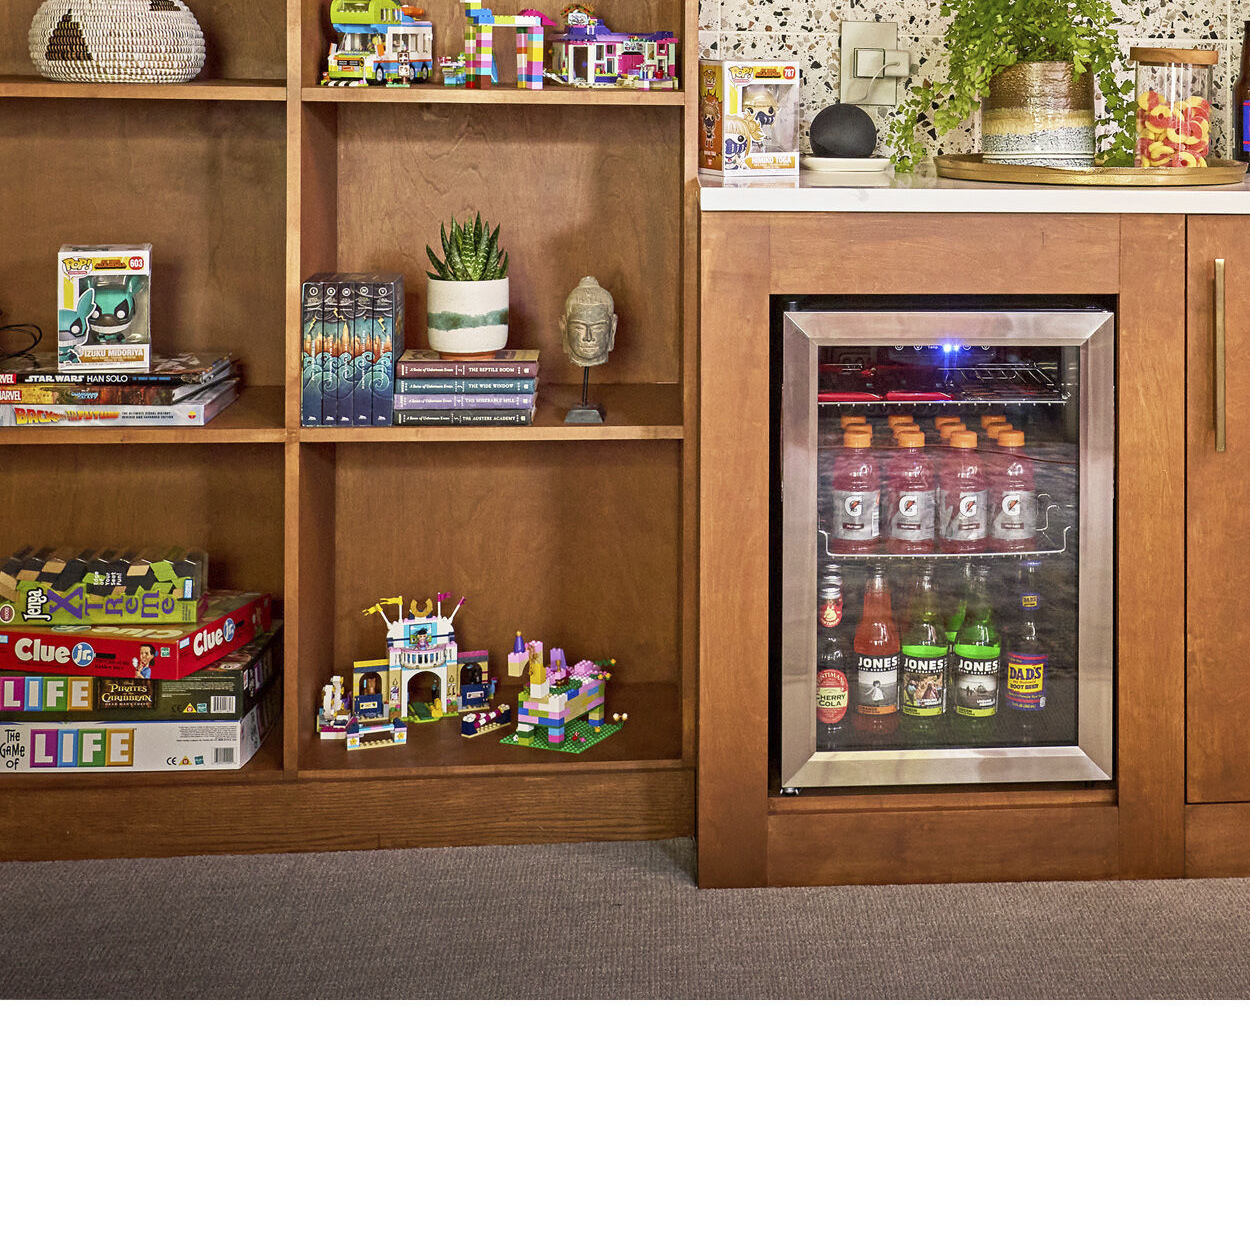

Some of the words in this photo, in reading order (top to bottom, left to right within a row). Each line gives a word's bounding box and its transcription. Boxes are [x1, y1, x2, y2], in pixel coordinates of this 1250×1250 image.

[729, 66, 754, 79] POP!
[61, 257, 92, 270] POP!
[130, 258, 144, 268] 603
[84, 349, 106, 358] IZUKU
[25, 375, 55, 383] STAR
[55, 375, 85, 383] WARS
[86, 375, 105, 383] HAN
[105, 375, 129, 383] SOLO
[14, 407, 56, 425] BACK
[844, 494, 863, 517] G
[898, 494, 918, 517] G
[959, 495, 977, 518] G
[1001, 494, 1021, 517] G
[23, 587, 50, 621] Jenga
[192, 628, 224, 656] Clue
[14, 637, 71, 664] Clue
[73, 643, 94, 666] jr.
[858, 656, 898, 669] JONES
[903, 658, 944, 671] JONES
[958, 659, 998, 671] JONES
[1010, 666, 1042, 681] DAD'S
[3, 679, 89, 708] LIFE
[108, 683, 148, 693] PIRATES
[101, 692, 153, 703] CARIBBEAN
[34, 732, 131, 763] LIFE
